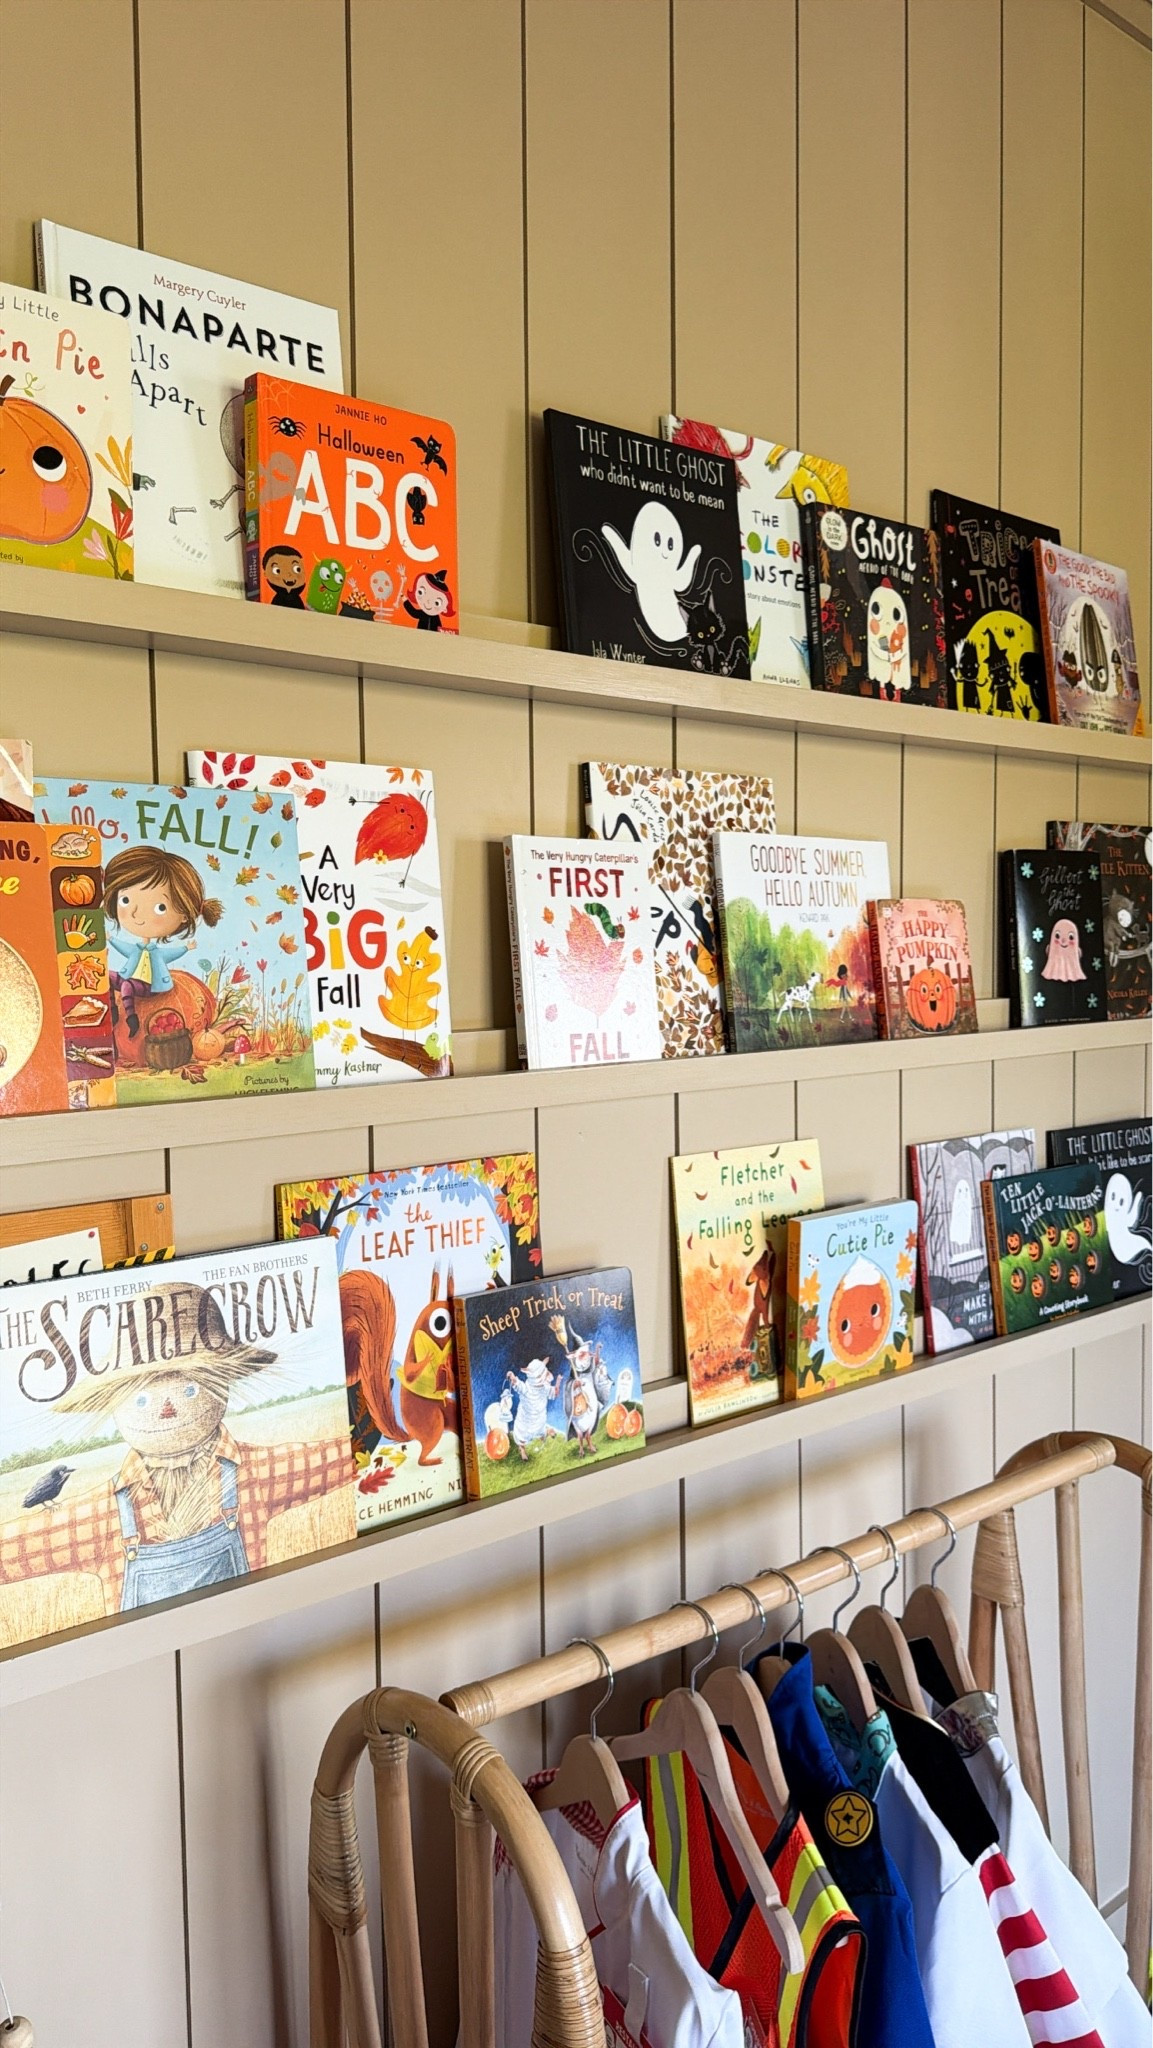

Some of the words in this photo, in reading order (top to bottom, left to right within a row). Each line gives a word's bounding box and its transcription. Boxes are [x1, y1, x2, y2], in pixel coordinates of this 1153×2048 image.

[153, 274, 204, 300] Margery
[206, 289, 247, 311] Cuyler
[13, 296, 60, 322] Little
[69, 274, 326, 375] BONAPARTE
[56, 328, 105, 380] Pie
[131, 334, 169, 371] lls
[131, 369, 208, 427] Apart
[335, 404, 370, 422] JANNIE
[374, 415, 388, 426] HO
[317, 423, 405, 464] Halloween
[576, 425, 610, 457] THE
[618, 436, 673, 474] LITTLE
[676, 452, 726, 487] GHOST
[580, 457, 604, 480] who
[639, 478, 667, 497] want
[669, 484, 681, 499] to
[682, 481, 696, 503] be
[698, 494, 725, 510] mean
[284, 449, 440, 562] ABC
[752, 509, 779, 528] THE
[135, 799, 261, 860] FALL!
[319, 844, 339, 870] A
[531, 850, 544, 860] The
[546, 850, 563, 862] Very
[565, 851, 593, 864] Hungry
[594, 851, 639, 864] Caterpillar's
[750, 844, 807, 875] GOODBYE
[301, 874, 356, 911] Very
[550, 867, 625, 898] FIRST
[765, 879, 803, 907] HELLO
[808, 881, 859, 908] AUTUMN
[902, 919, 949, 938] HAPPY
[511, 944, 520, 974] FIRST
[896, 940, 958, 963] PUMPKIN
[317, 973, 361, 1013] Fall
[514, 976, 522, 1000] FALL
[569, 1031, 630, 1063] FALL
[244, 1075, 278, 1086] Pictures
[279, 1074, 290, 1086] by
[344, 1060, 384, 1077] Kastner
[1066, 1135, 1088, 1157] THE
[1091, 1129, 1125, 1153] LITTLE
[1120, 1156, 1128, 1168] to
[1127, 1150, 1138, 1166] be
[720, 1162, 785, 1186] Fletcher
[401, 1188, 414, 1196] York
[417, 1186, 436, 1194] Times
[735, 1192, 753, 1206] and
[758, 1190, 775, 1204] the
[1000, 1181, 1022, 1203] TEN
[1010, 1182, 1045, 1213] LITTLE
[404, 1202, 432, 1223] the
[361, 1229, 415, 1262] LEAF
[425, 1216, 486, 1252] THIEF
[699, 1217, 753, 1246] Falling
[827, 1233, 868, 1257] Cutie
[874, 1223, 894, 1248] Pie
[203, 1269, 226, 1282] THE
[228, 1264, 250, 1278] FAN
[253, 1254, 308, 1274] BROTHERS
[77, 1289, 110, 1304] BETH
[113, 1279, 153, 1299] FERRY
[963, 1293, 987, 1312] MAKE
[479, 1306, 520, 1341] Sheep
[523, 1286, 566, 1319] Trick
[568, 1290, 584, 1306] or
[588, 1287, 625, 1311] Treat
[968, 1310, 987, 1325] WITH
[18, 1266, 320, 1403] SCARECROW
[378, 1487, 433, 1514] HEMMING
